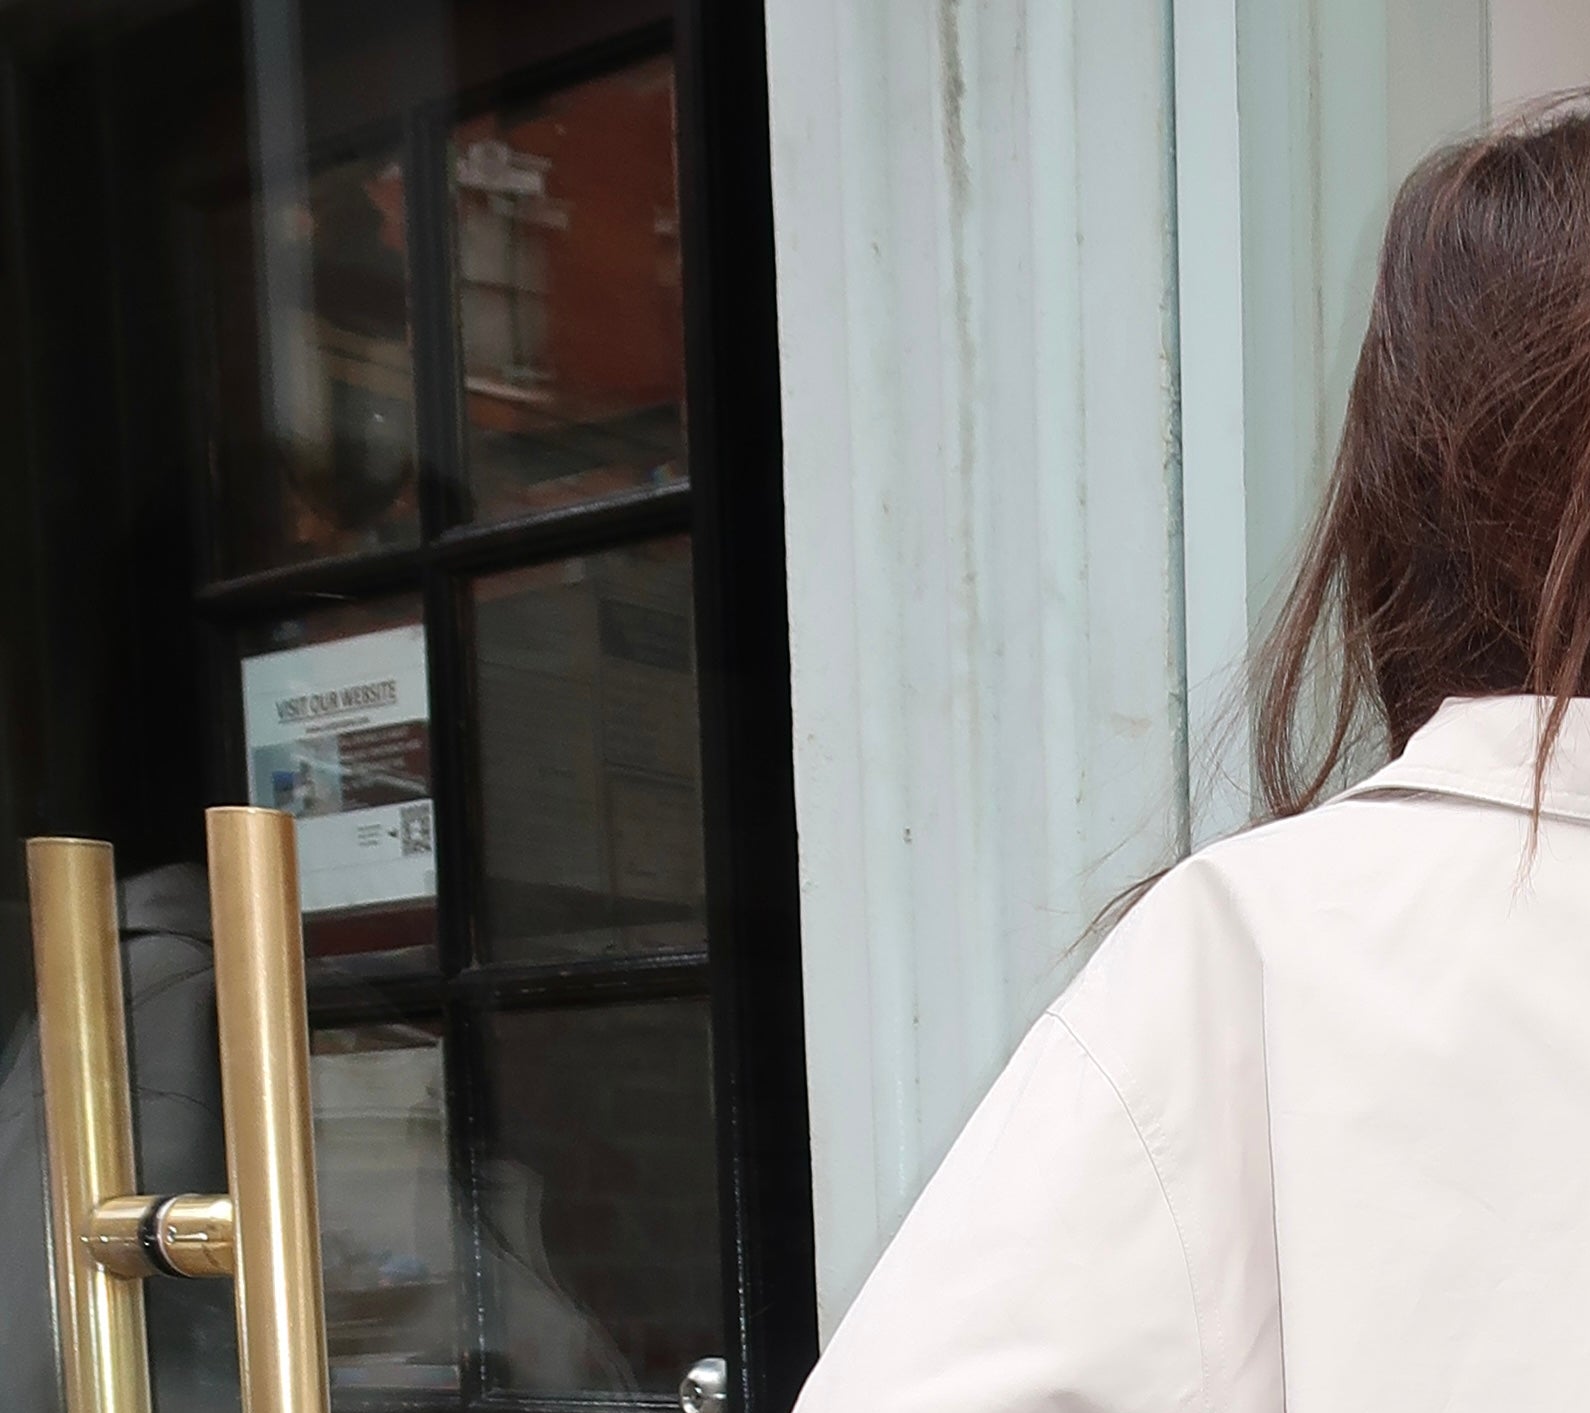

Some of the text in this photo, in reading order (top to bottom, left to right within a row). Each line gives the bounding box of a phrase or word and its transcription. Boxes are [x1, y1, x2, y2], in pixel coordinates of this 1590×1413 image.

[275, 679, 397, 719] VISIT OUR WEBSITE
